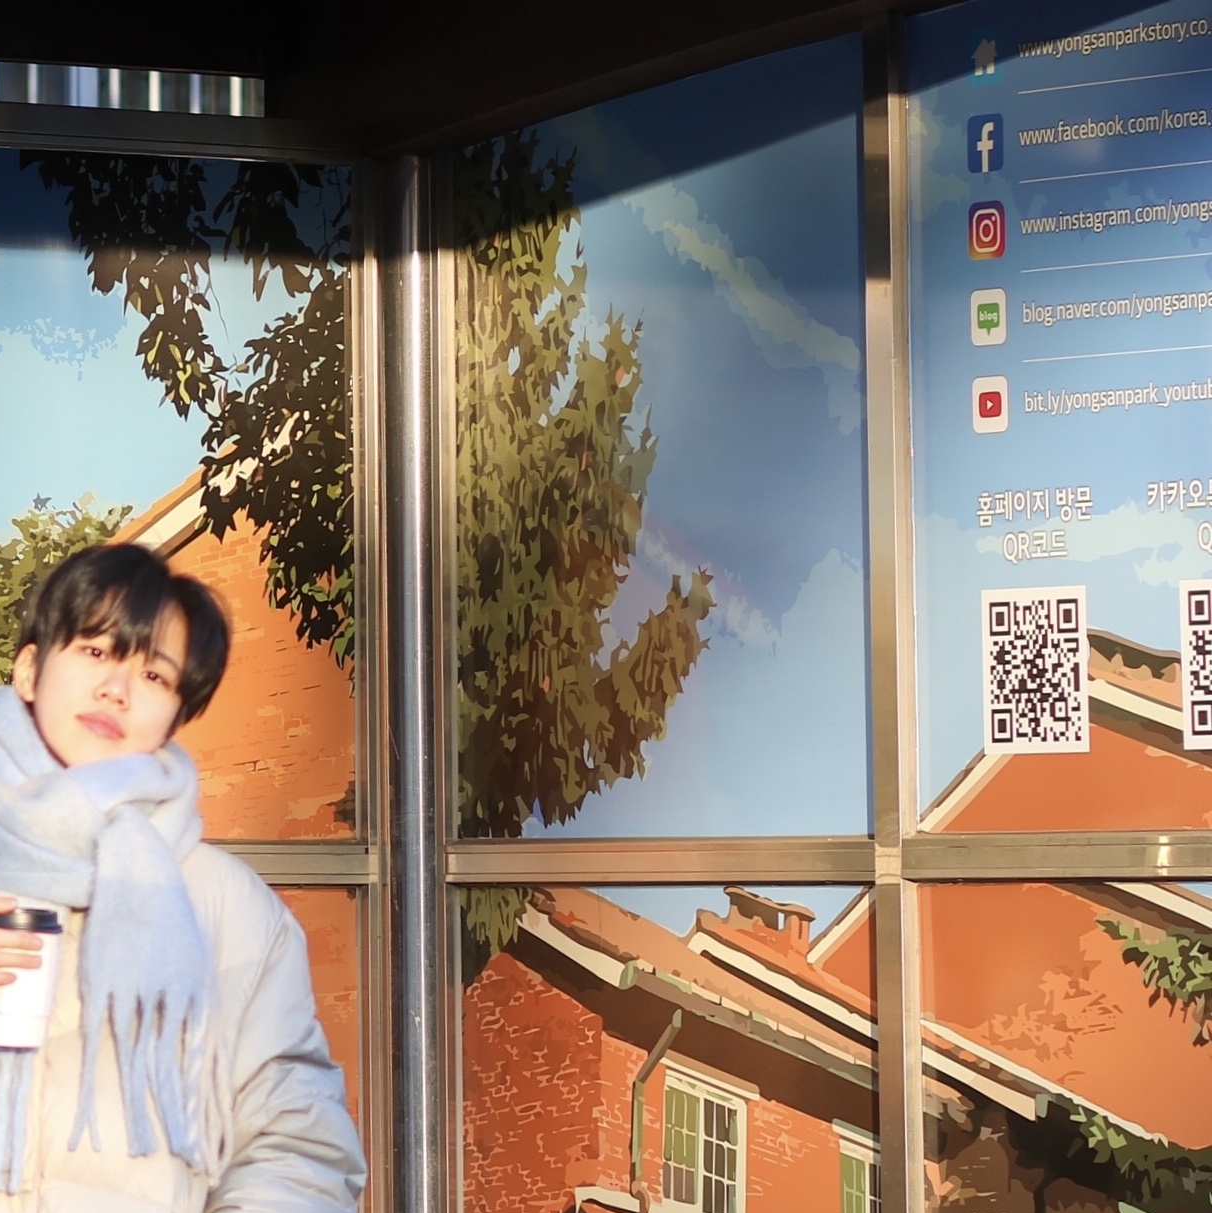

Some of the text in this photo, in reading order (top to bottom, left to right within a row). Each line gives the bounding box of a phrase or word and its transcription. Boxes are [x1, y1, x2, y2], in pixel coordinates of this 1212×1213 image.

[1018, 109, 1212, 146] www.facebook.com/korea.
[979, 310, 998, 323] blog
[976, 486, 1094, 527] 홈페이지 방문
[1003, 530, 1068, 564] QR코드
